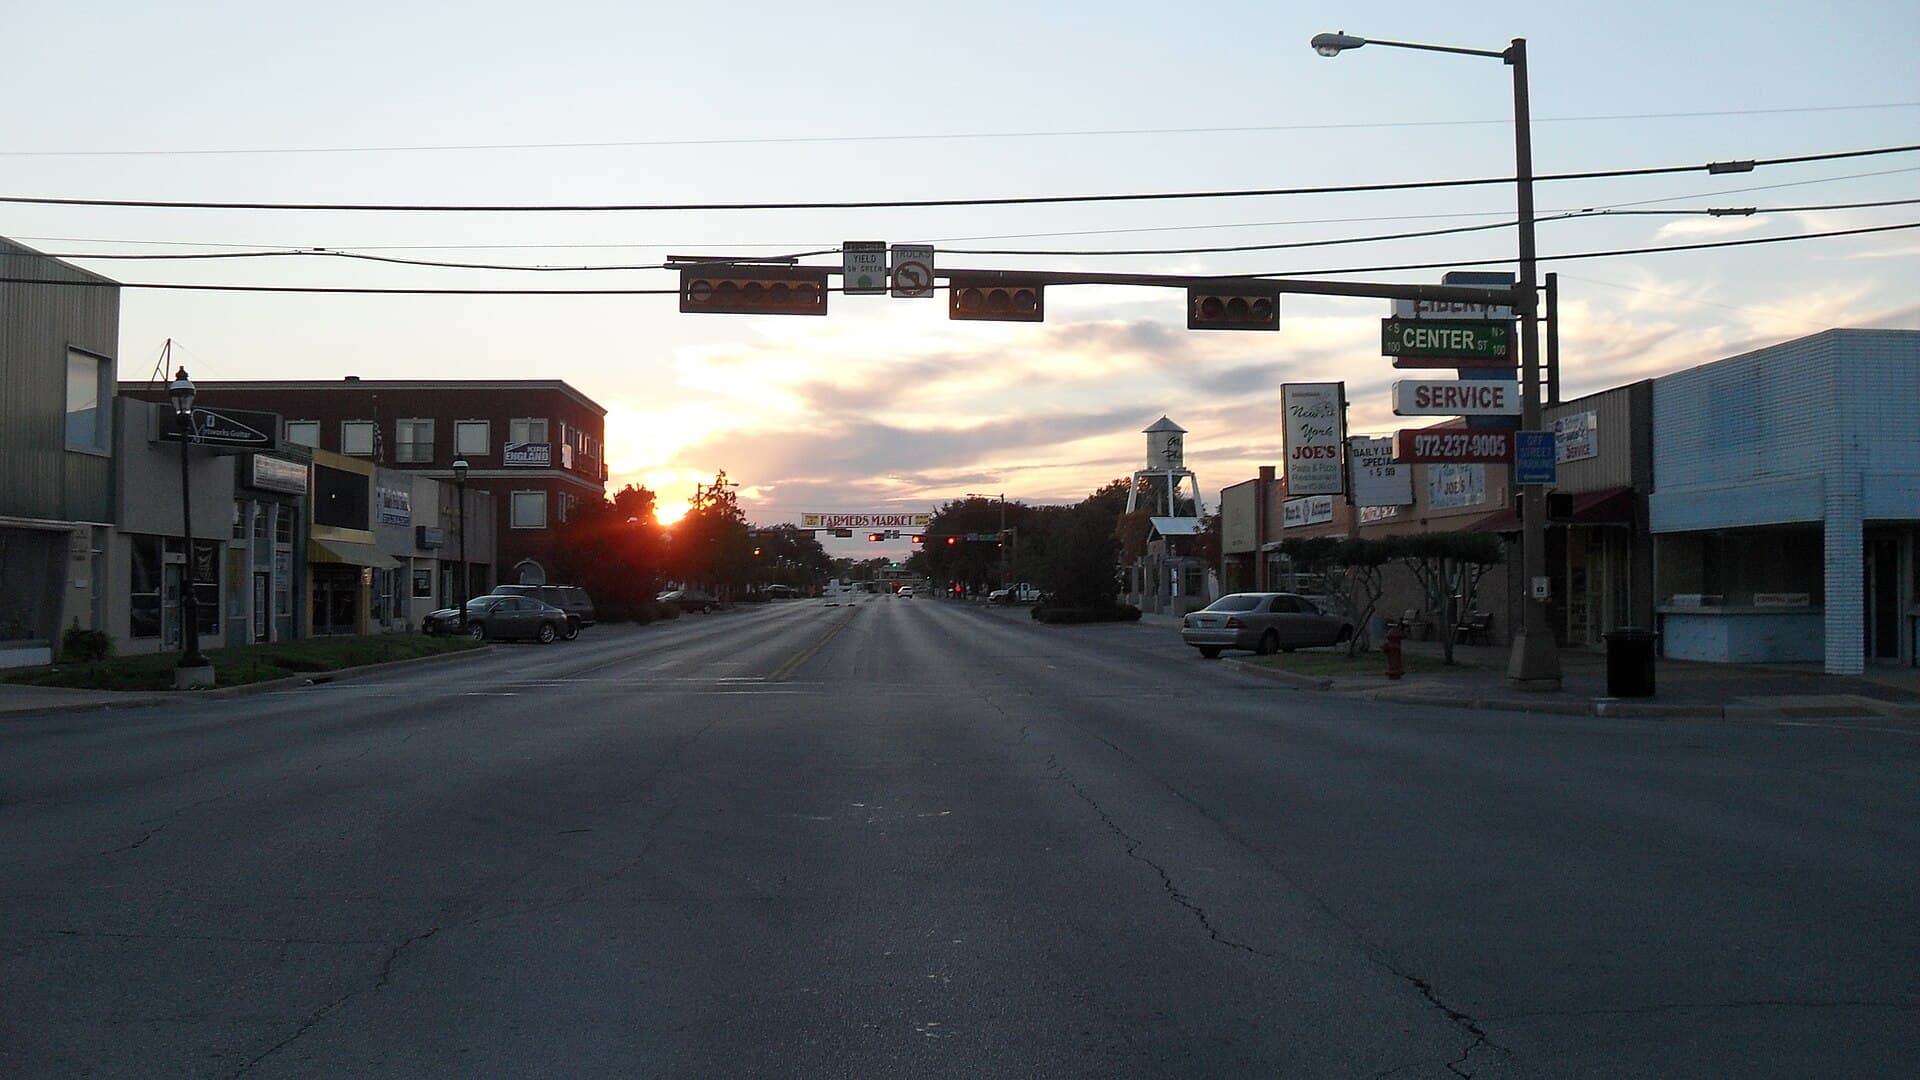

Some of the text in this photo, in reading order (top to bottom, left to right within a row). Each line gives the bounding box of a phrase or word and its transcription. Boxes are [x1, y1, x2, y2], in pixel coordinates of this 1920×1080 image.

[854, 254, 877, 263] YIELD
[1402, 328, 1489, 351] CENTER ST
[1415, 385, 1504, 409] SERVICE
[1290, 405, 1318, 418] New
[1301, 423, 1333, 443] York
[1353, 447, 1379, 457] DAILY
[1415, 434, 1506, 457] 972-237-9005
[506, 451, 549, 461] ENGLAND
[1292, 445, 1336, 460] JOE'S
[1362, 458, 1393, 467] SPECIA
[820, 515, 869, 526] FARMERS
[872, 515, 913, 526] MARKET
